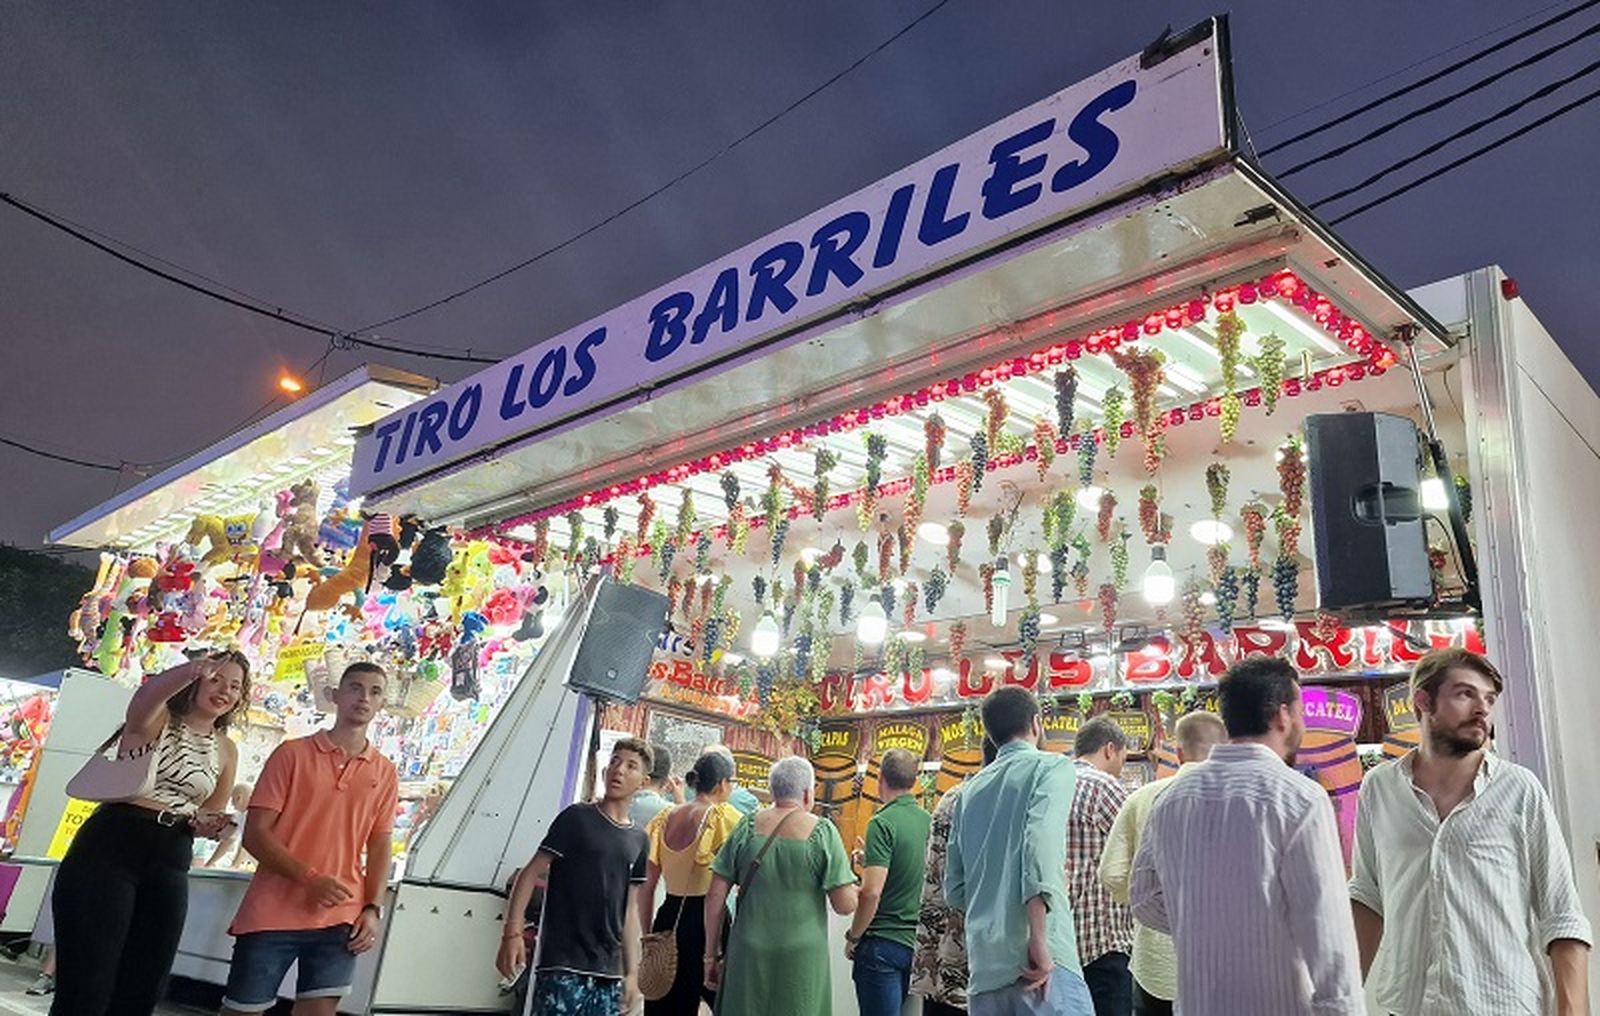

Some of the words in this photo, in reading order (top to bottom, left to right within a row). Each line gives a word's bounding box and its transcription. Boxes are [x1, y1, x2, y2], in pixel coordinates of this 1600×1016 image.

[373, 383, 483, 473] TIRO
[499, 326, 608, 421] LOS
[644, 79, 1137, 363] BARRILES
[1301, 700, 1354, 721] CATEL
